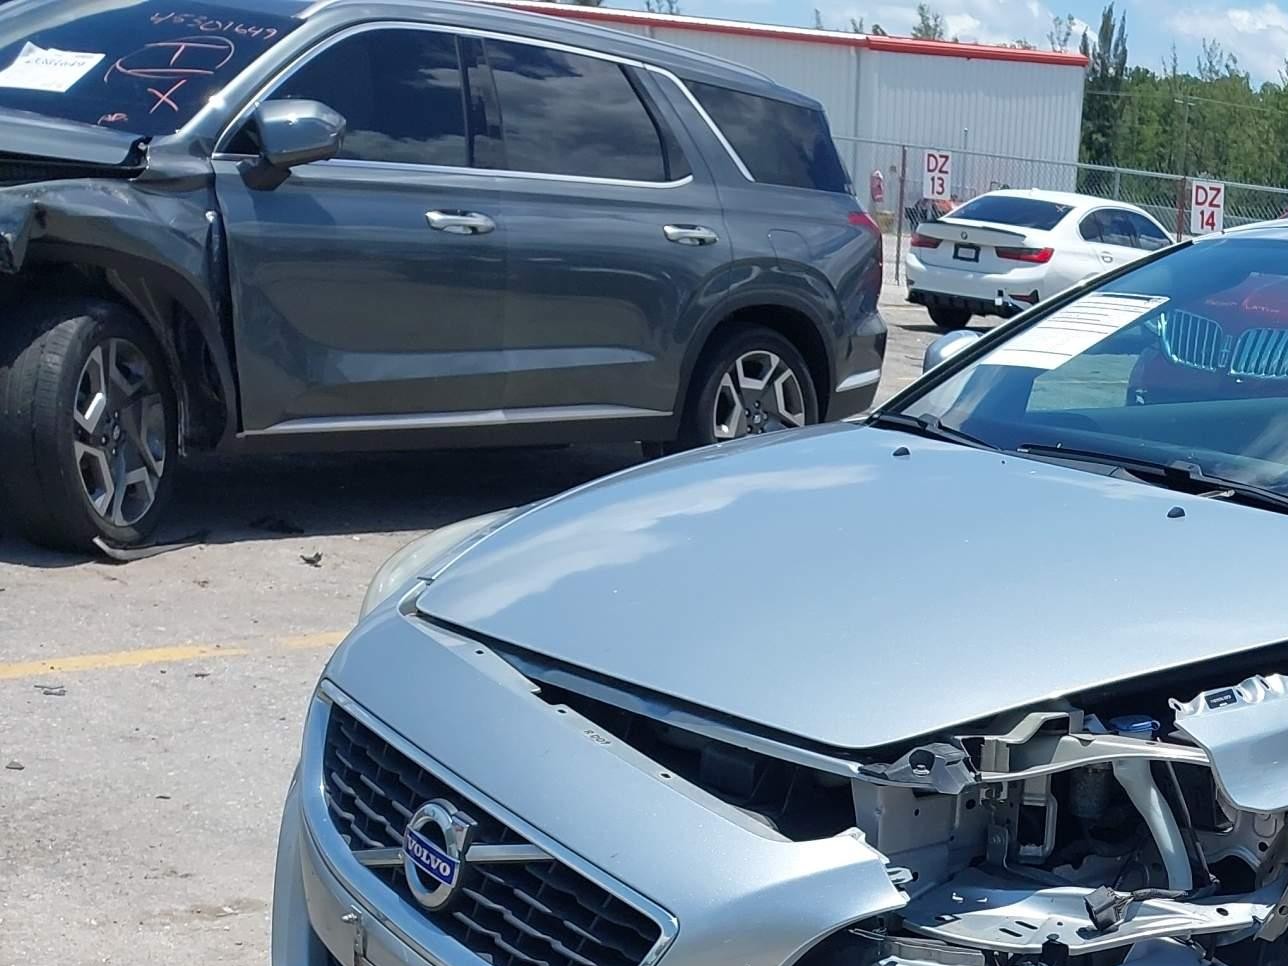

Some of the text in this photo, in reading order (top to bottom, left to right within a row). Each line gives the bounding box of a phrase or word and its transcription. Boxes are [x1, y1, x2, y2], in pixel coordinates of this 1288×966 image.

[926, 153, 949, 174] DZ
[930, 176, 945, 195] 13
[1194, 186, 1221, 208] DZ
[1199, 210, 1216, 231] 14
[406, 834, 451, 877] VOLVO
